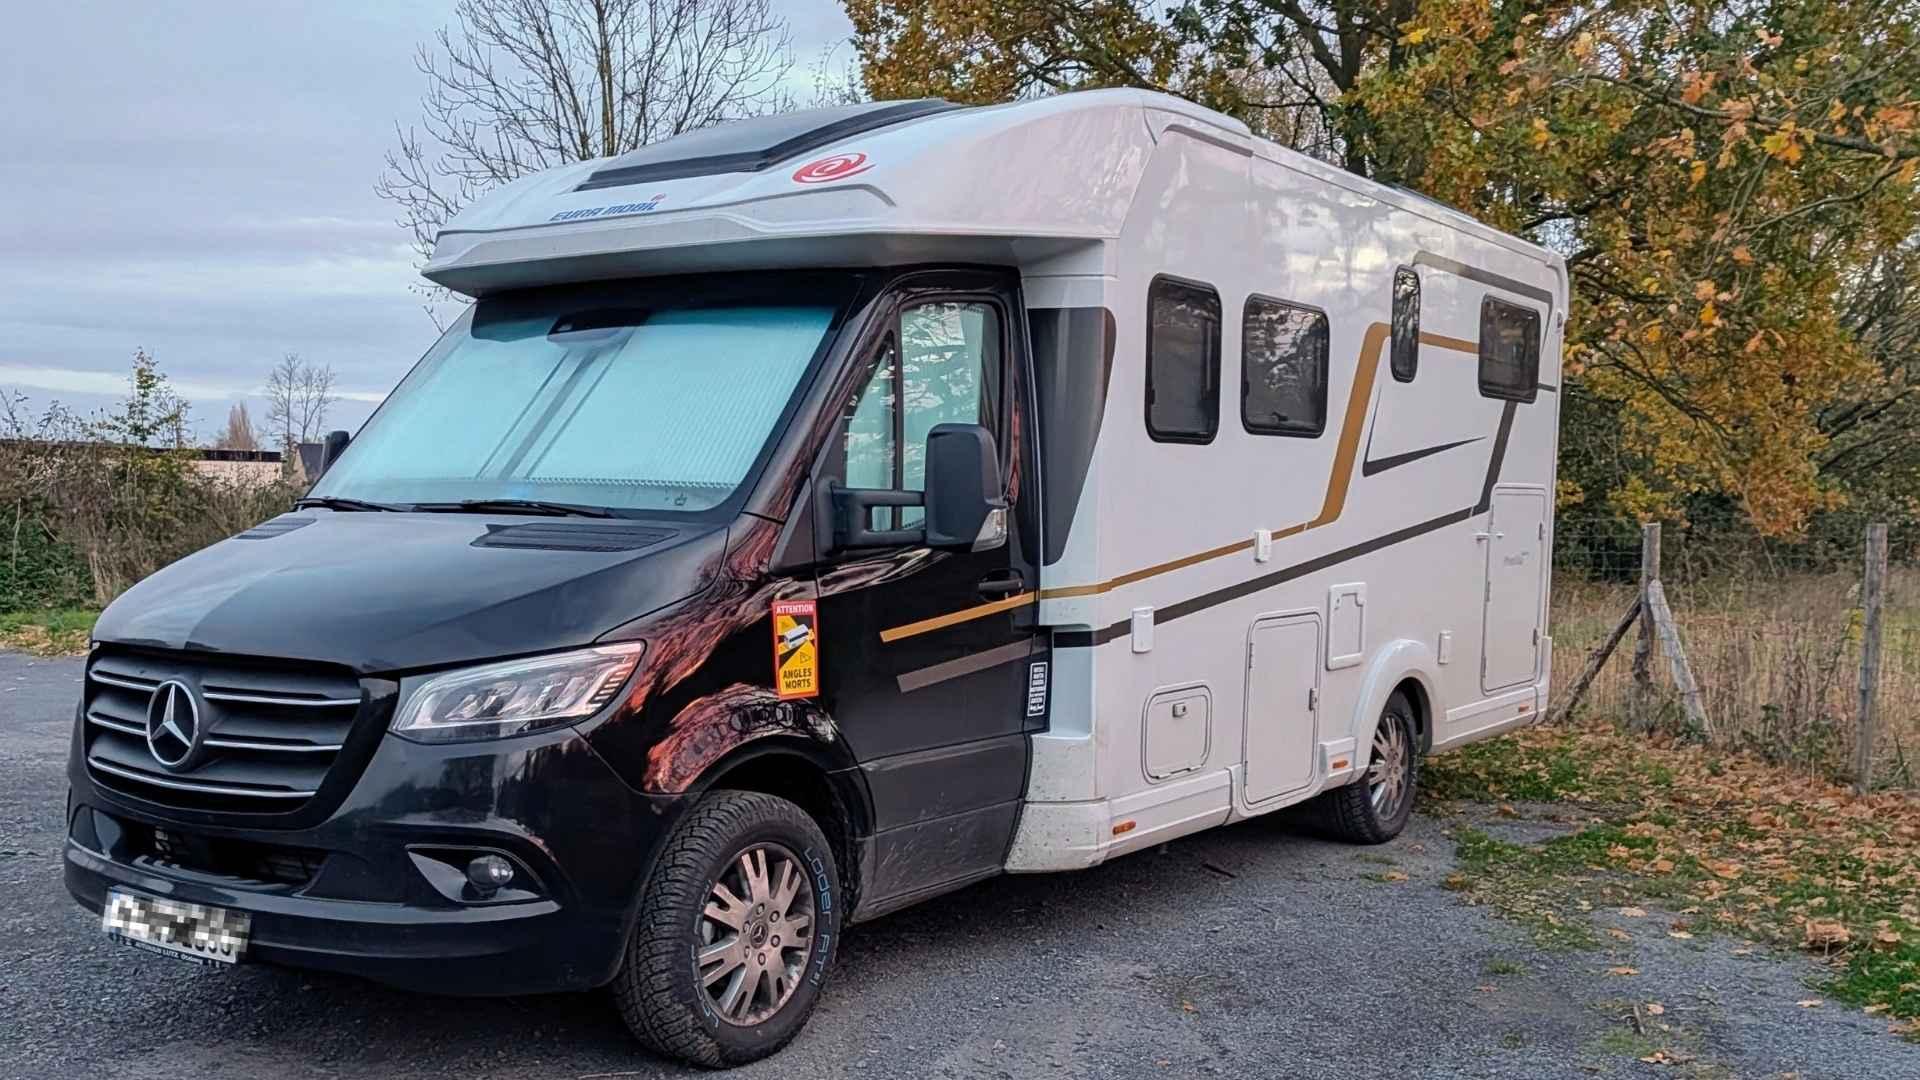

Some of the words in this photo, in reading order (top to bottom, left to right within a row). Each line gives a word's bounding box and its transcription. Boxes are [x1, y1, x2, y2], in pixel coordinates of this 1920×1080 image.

[776, 604, 814, 614] ATTENTION
[783, 668, 812, 680] ANGLES
[785, 678, 811, 689] MORTS
